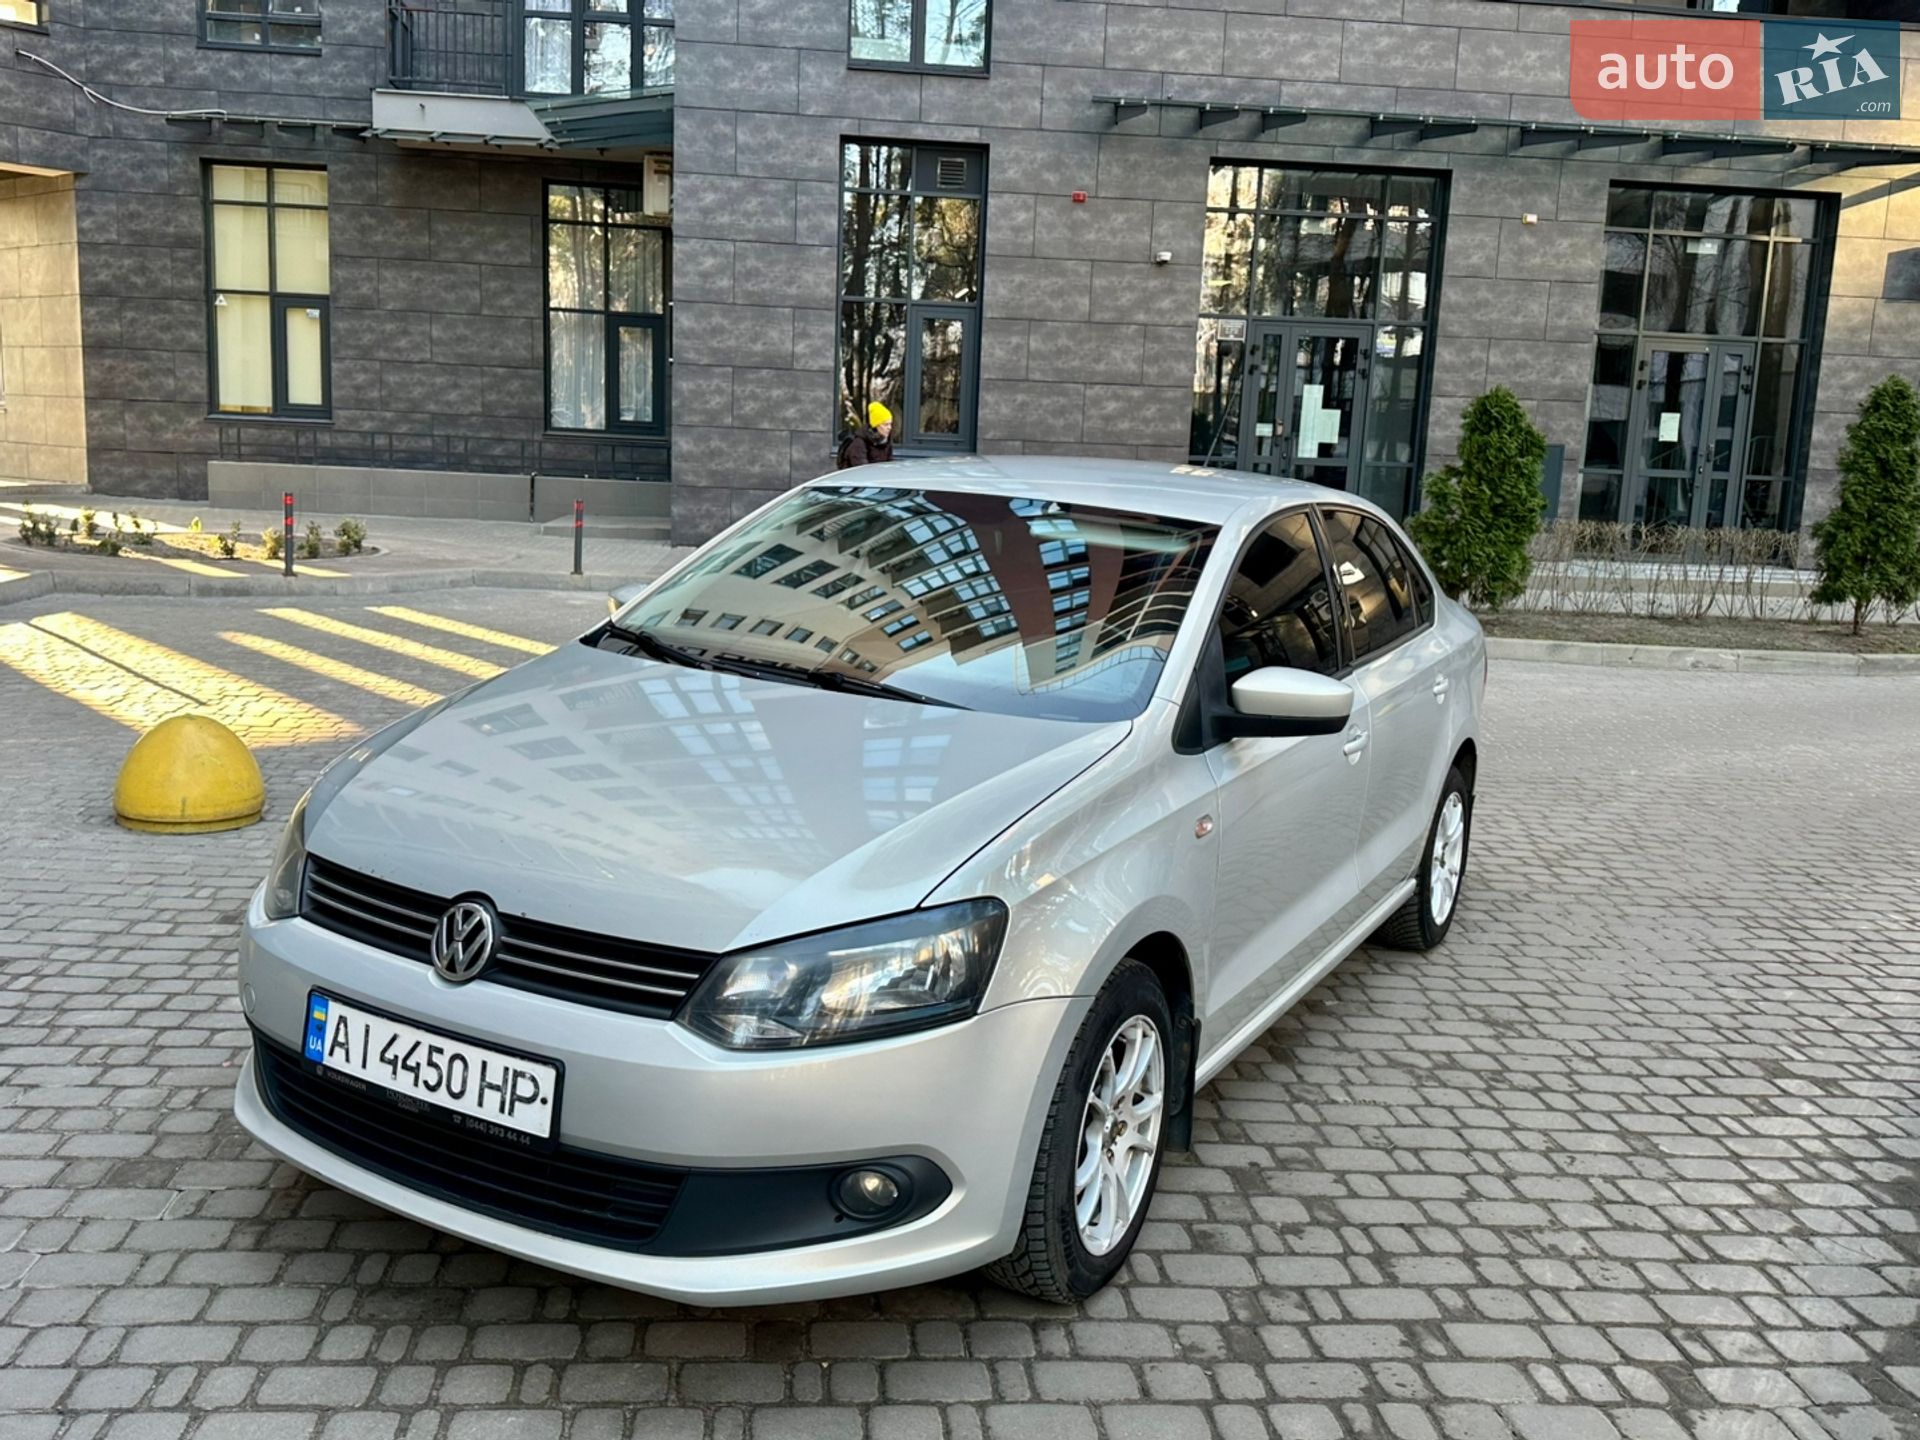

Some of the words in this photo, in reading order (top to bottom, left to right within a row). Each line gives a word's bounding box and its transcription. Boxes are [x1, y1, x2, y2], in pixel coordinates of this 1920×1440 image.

[309, 1035, 322, 1052] UA
[379, 1033, 469, 1100] 4450
[477, 1060, 541, 1117] HP
